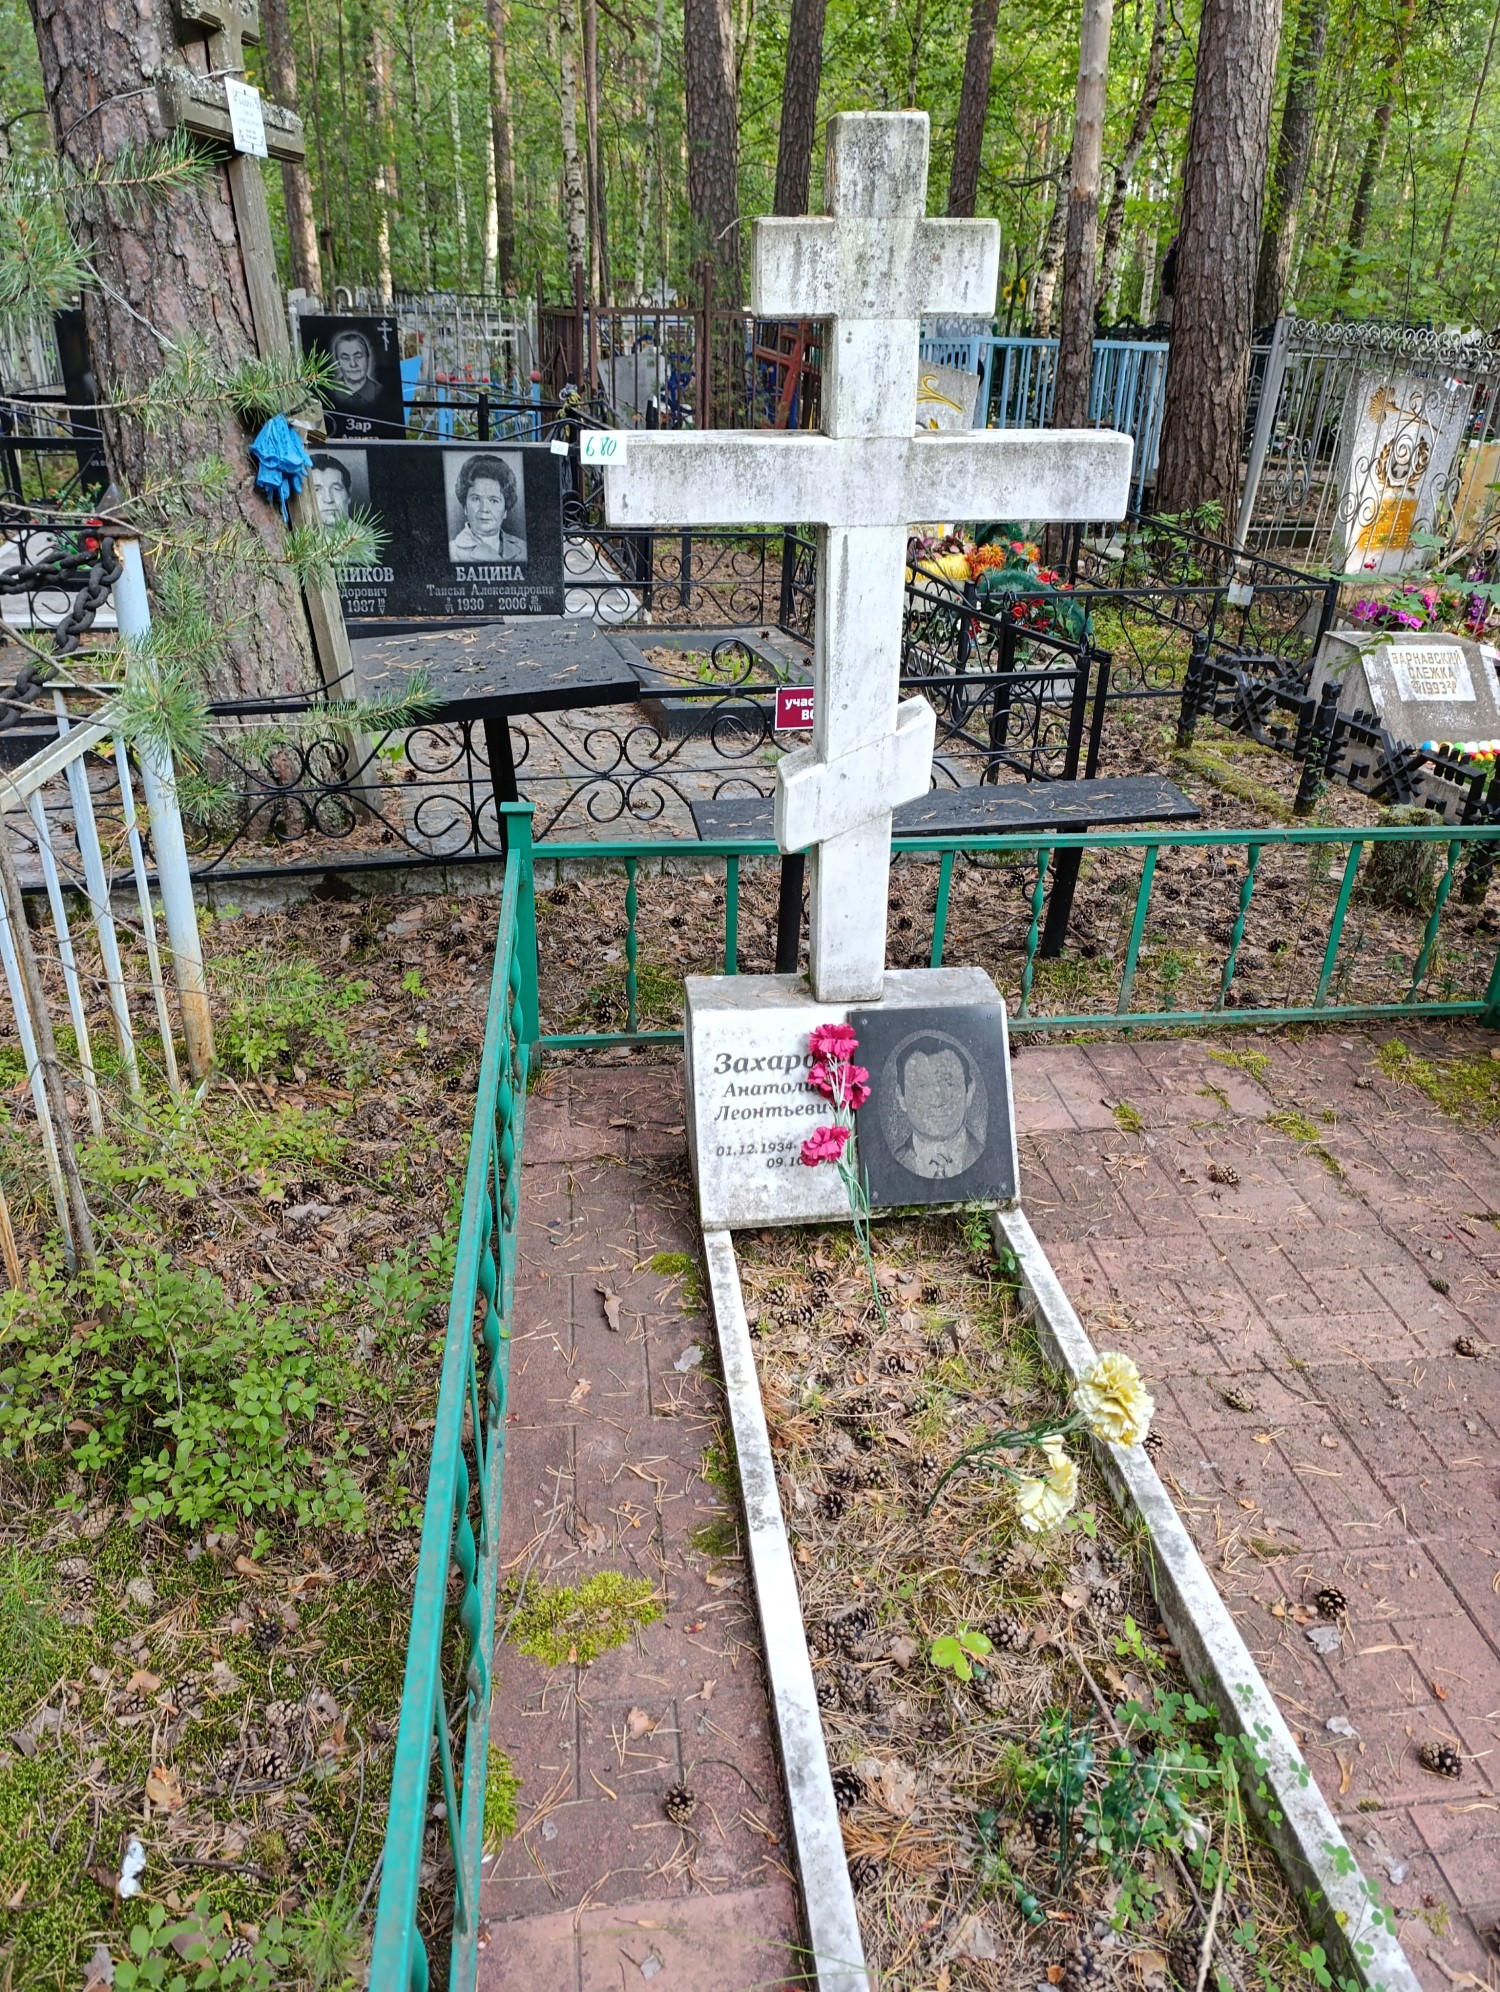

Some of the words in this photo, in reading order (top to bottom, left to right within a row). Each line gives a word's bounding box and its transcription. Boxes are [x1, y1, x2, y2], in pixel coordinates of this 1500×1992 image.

[345, 418, 372, 433] Зар
[586, 436, 617, 457] 680
[455, 566, 525, 584] БАЦИНА
[426, 584, 466, 596] Таисья
[470, 583, 555, 597] Александровна
[347, 599, 375, 613] 1987
[457, 597, 485, 611] 1930
[498, 597, 527, 611] 2006
[1391, 649, 1462, 665] ВАРНАВСКИЙ
[1407, 666, 1457, 679] ОЛЕЖКА
[714, 1052, 816, 1075] Захаро
[723, 1080, 815, 1098] Анатоли
[714, 1102, 828, 1122] Леонтьеви
